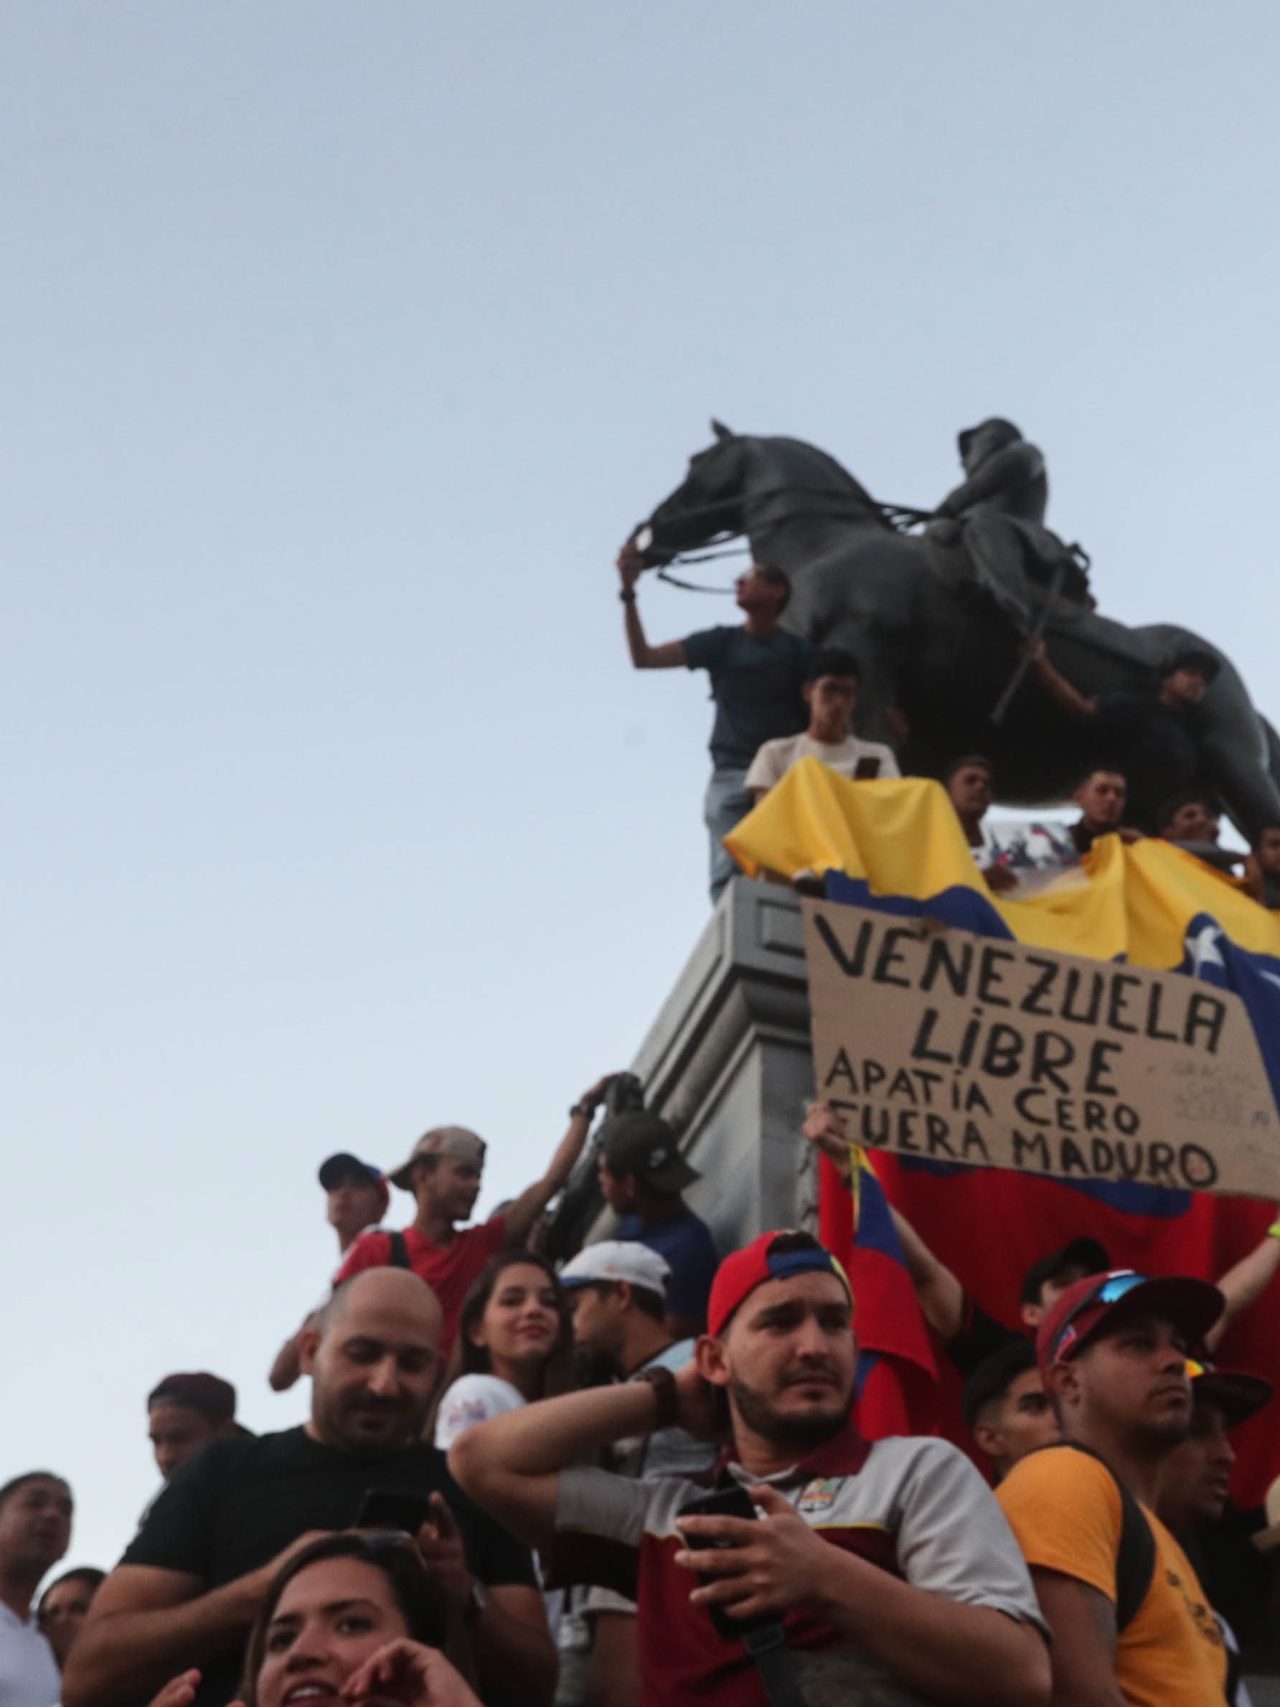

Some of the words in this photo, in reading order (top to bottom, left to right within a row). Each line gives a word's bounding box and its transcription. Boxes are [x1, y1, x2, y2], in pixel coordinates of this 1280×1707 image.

[814, 913, 1227, 1054] VENEZUELA
[1014, 1087, 1140, 1136] CERO
[1011, 1130, 1219, 1189] MADURO
